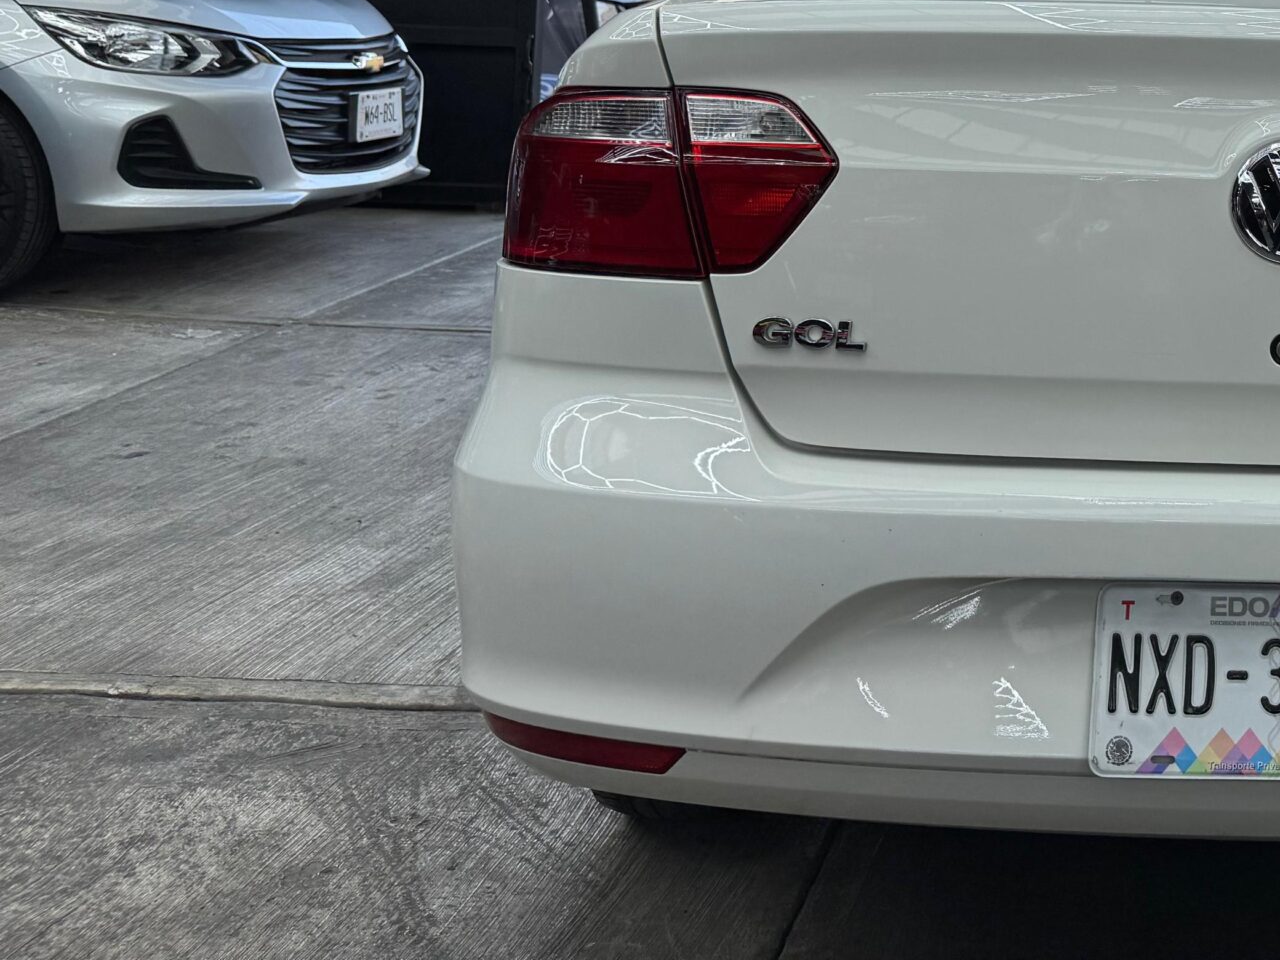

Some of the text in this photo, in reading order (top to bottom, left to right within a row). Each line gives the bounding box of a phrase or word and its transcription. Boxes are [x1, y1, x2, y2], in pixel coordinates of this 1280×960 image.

[752, 316, 868, 352] GOL
[1121, 599, 1136, 621] T
[1208, 761, 1255, 771] Transporte
